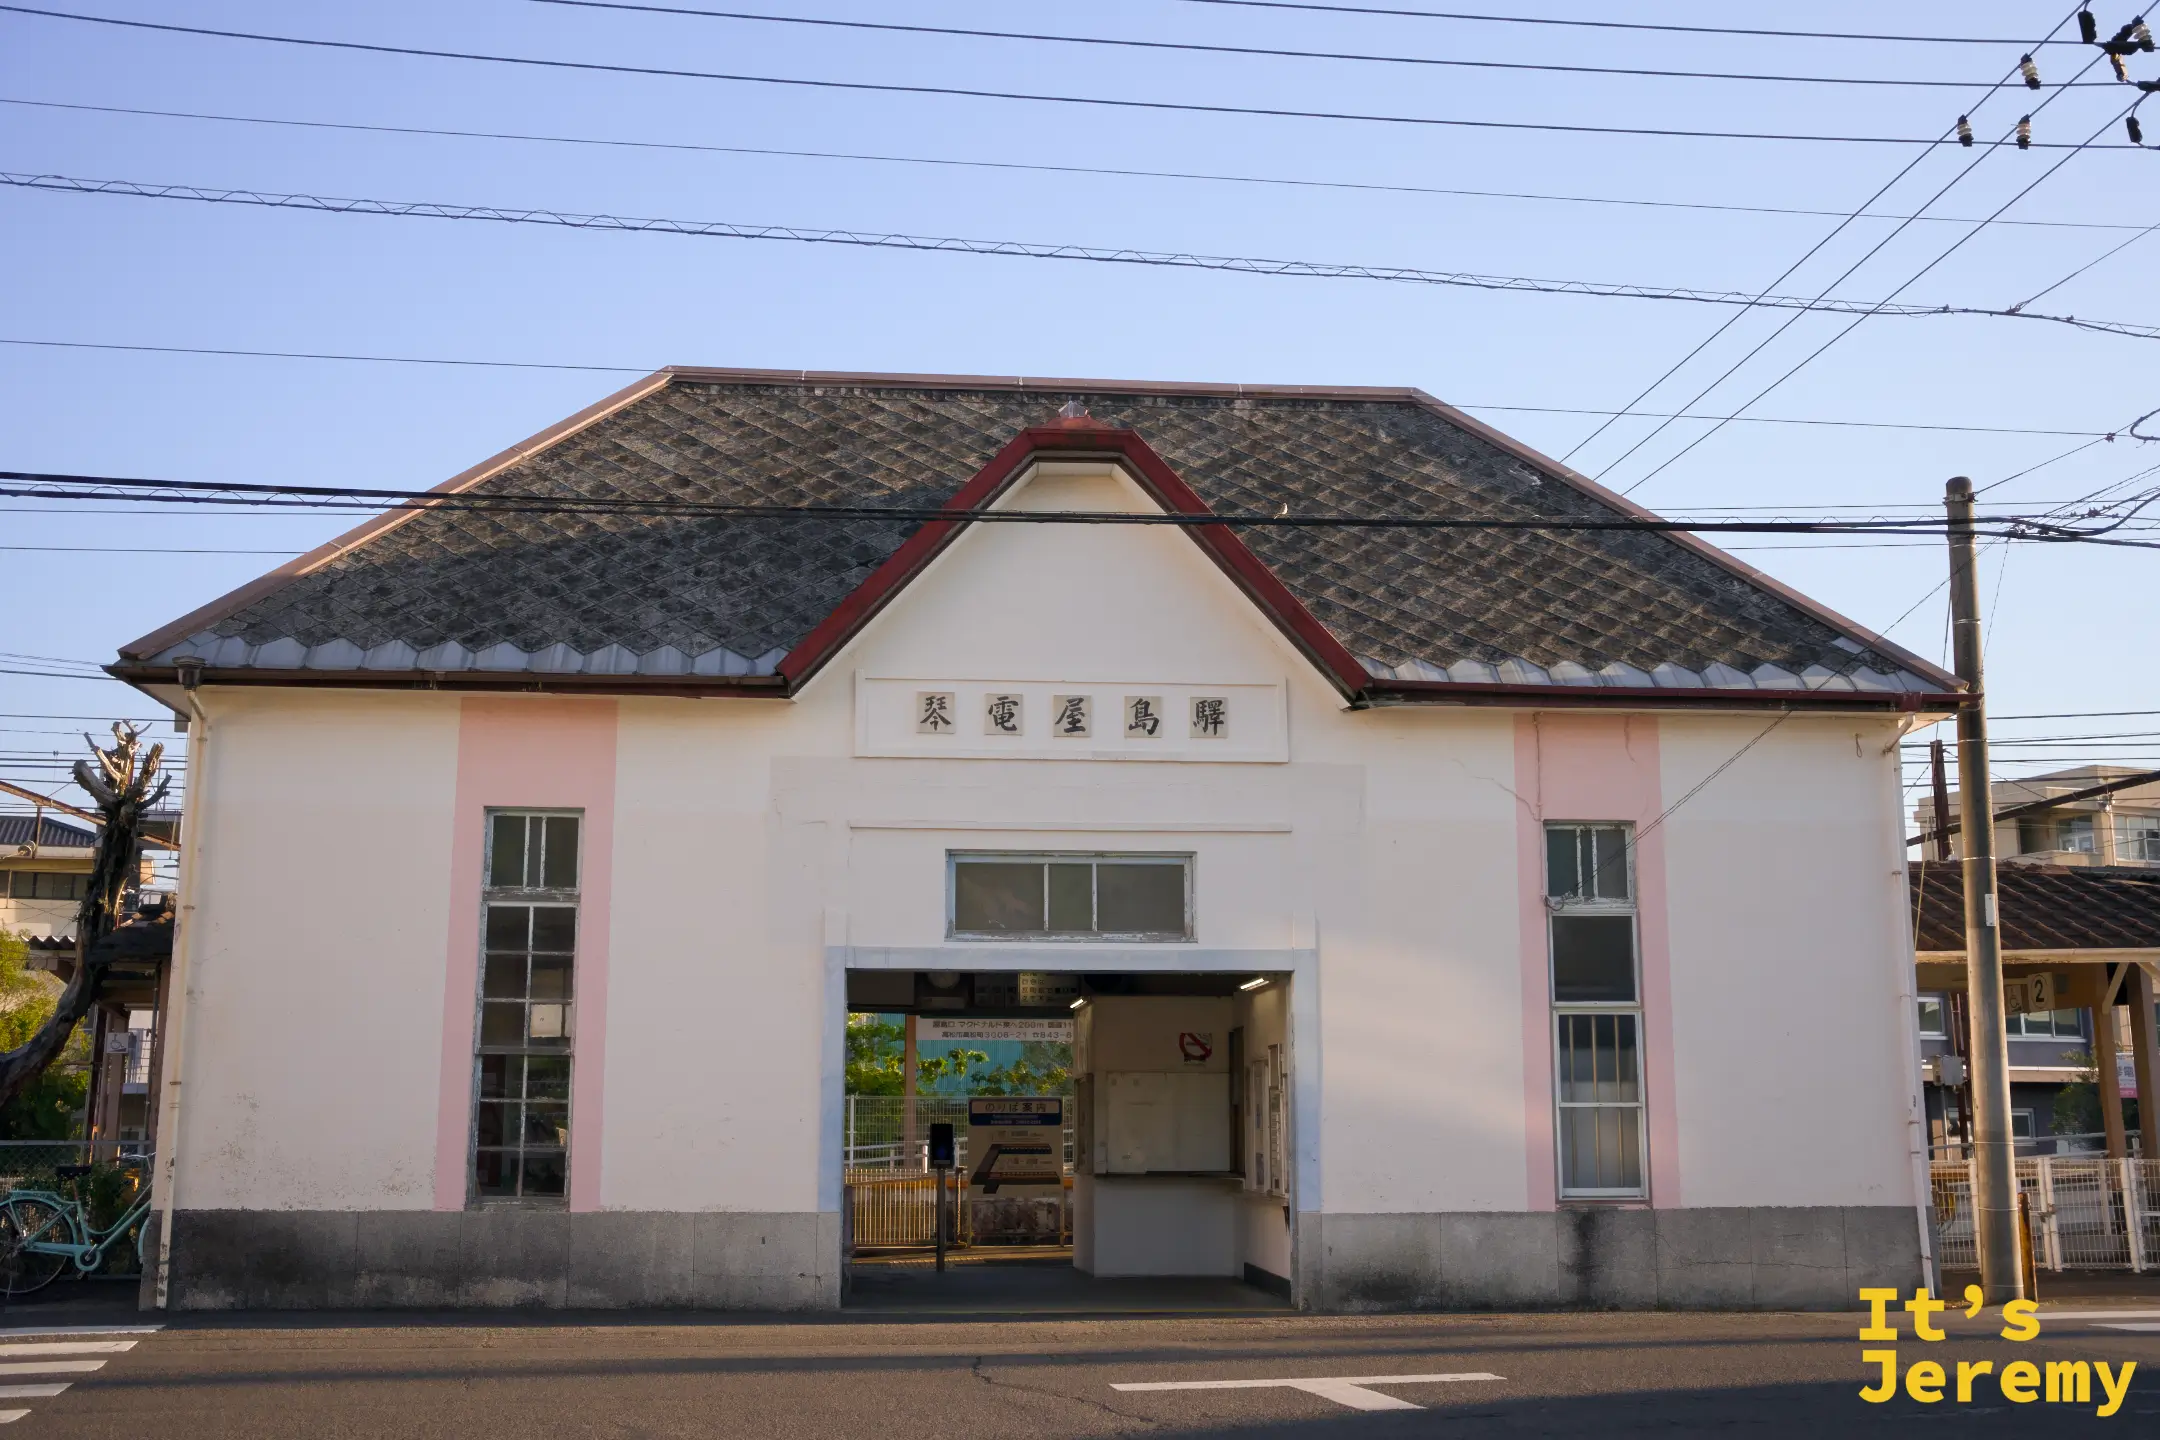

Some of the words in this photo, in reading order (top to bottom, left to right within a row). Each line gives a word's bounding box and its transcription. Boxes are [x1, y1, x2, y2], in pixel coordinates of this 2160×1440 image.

[2034, 979, 2045, 1003] 2
[985, 1102, 1047, 1113] のりば案内
